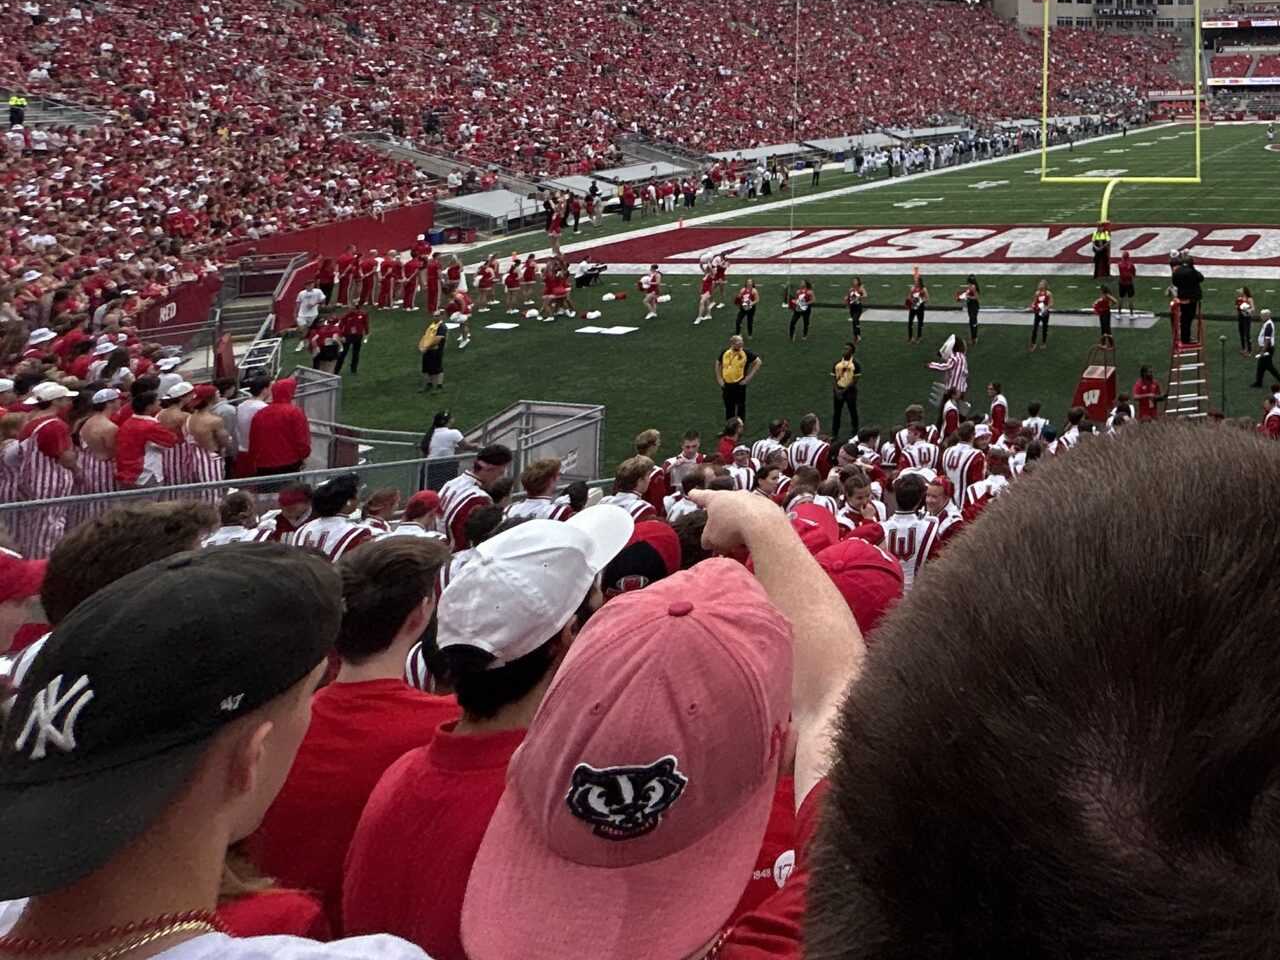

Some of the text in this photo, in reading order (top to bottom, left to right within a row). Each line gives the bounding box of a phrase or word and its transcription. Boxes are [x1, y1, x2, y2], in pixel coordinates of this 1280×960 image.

[159, 302, 177, 323] RED
[888, 527, 917, 562] W
[15, 673, 95, 761] NY
